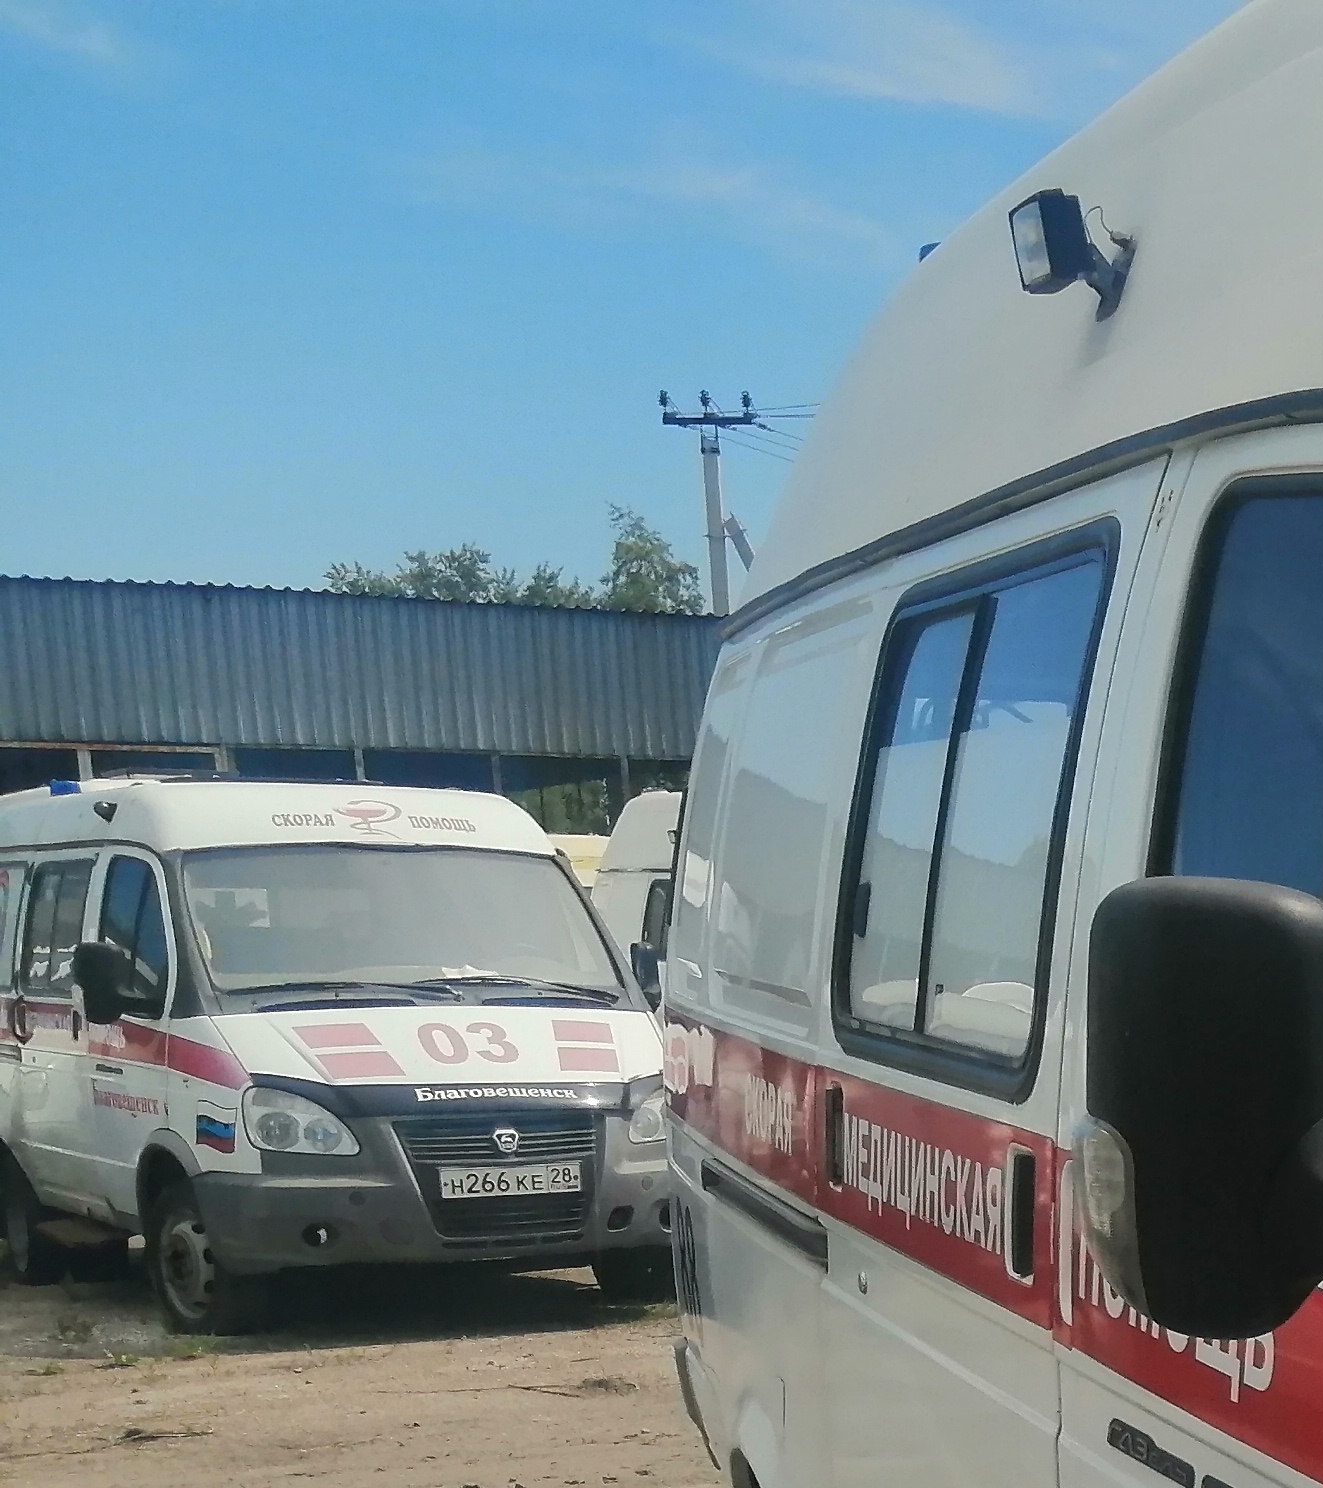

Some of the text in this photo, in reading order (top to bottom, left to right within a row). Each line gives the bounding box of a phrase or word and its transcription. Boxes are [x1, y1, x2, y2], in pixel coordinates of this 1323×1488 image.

[271, 813, 477, 833] СКОРАЯ ПОМОЩЬ
[417, 1020, 519, 1065] 03
[550, 1167, 573, 1183] 28
[843, 1112, 1002, 1255] МЕДИЦИНСКАЯ
